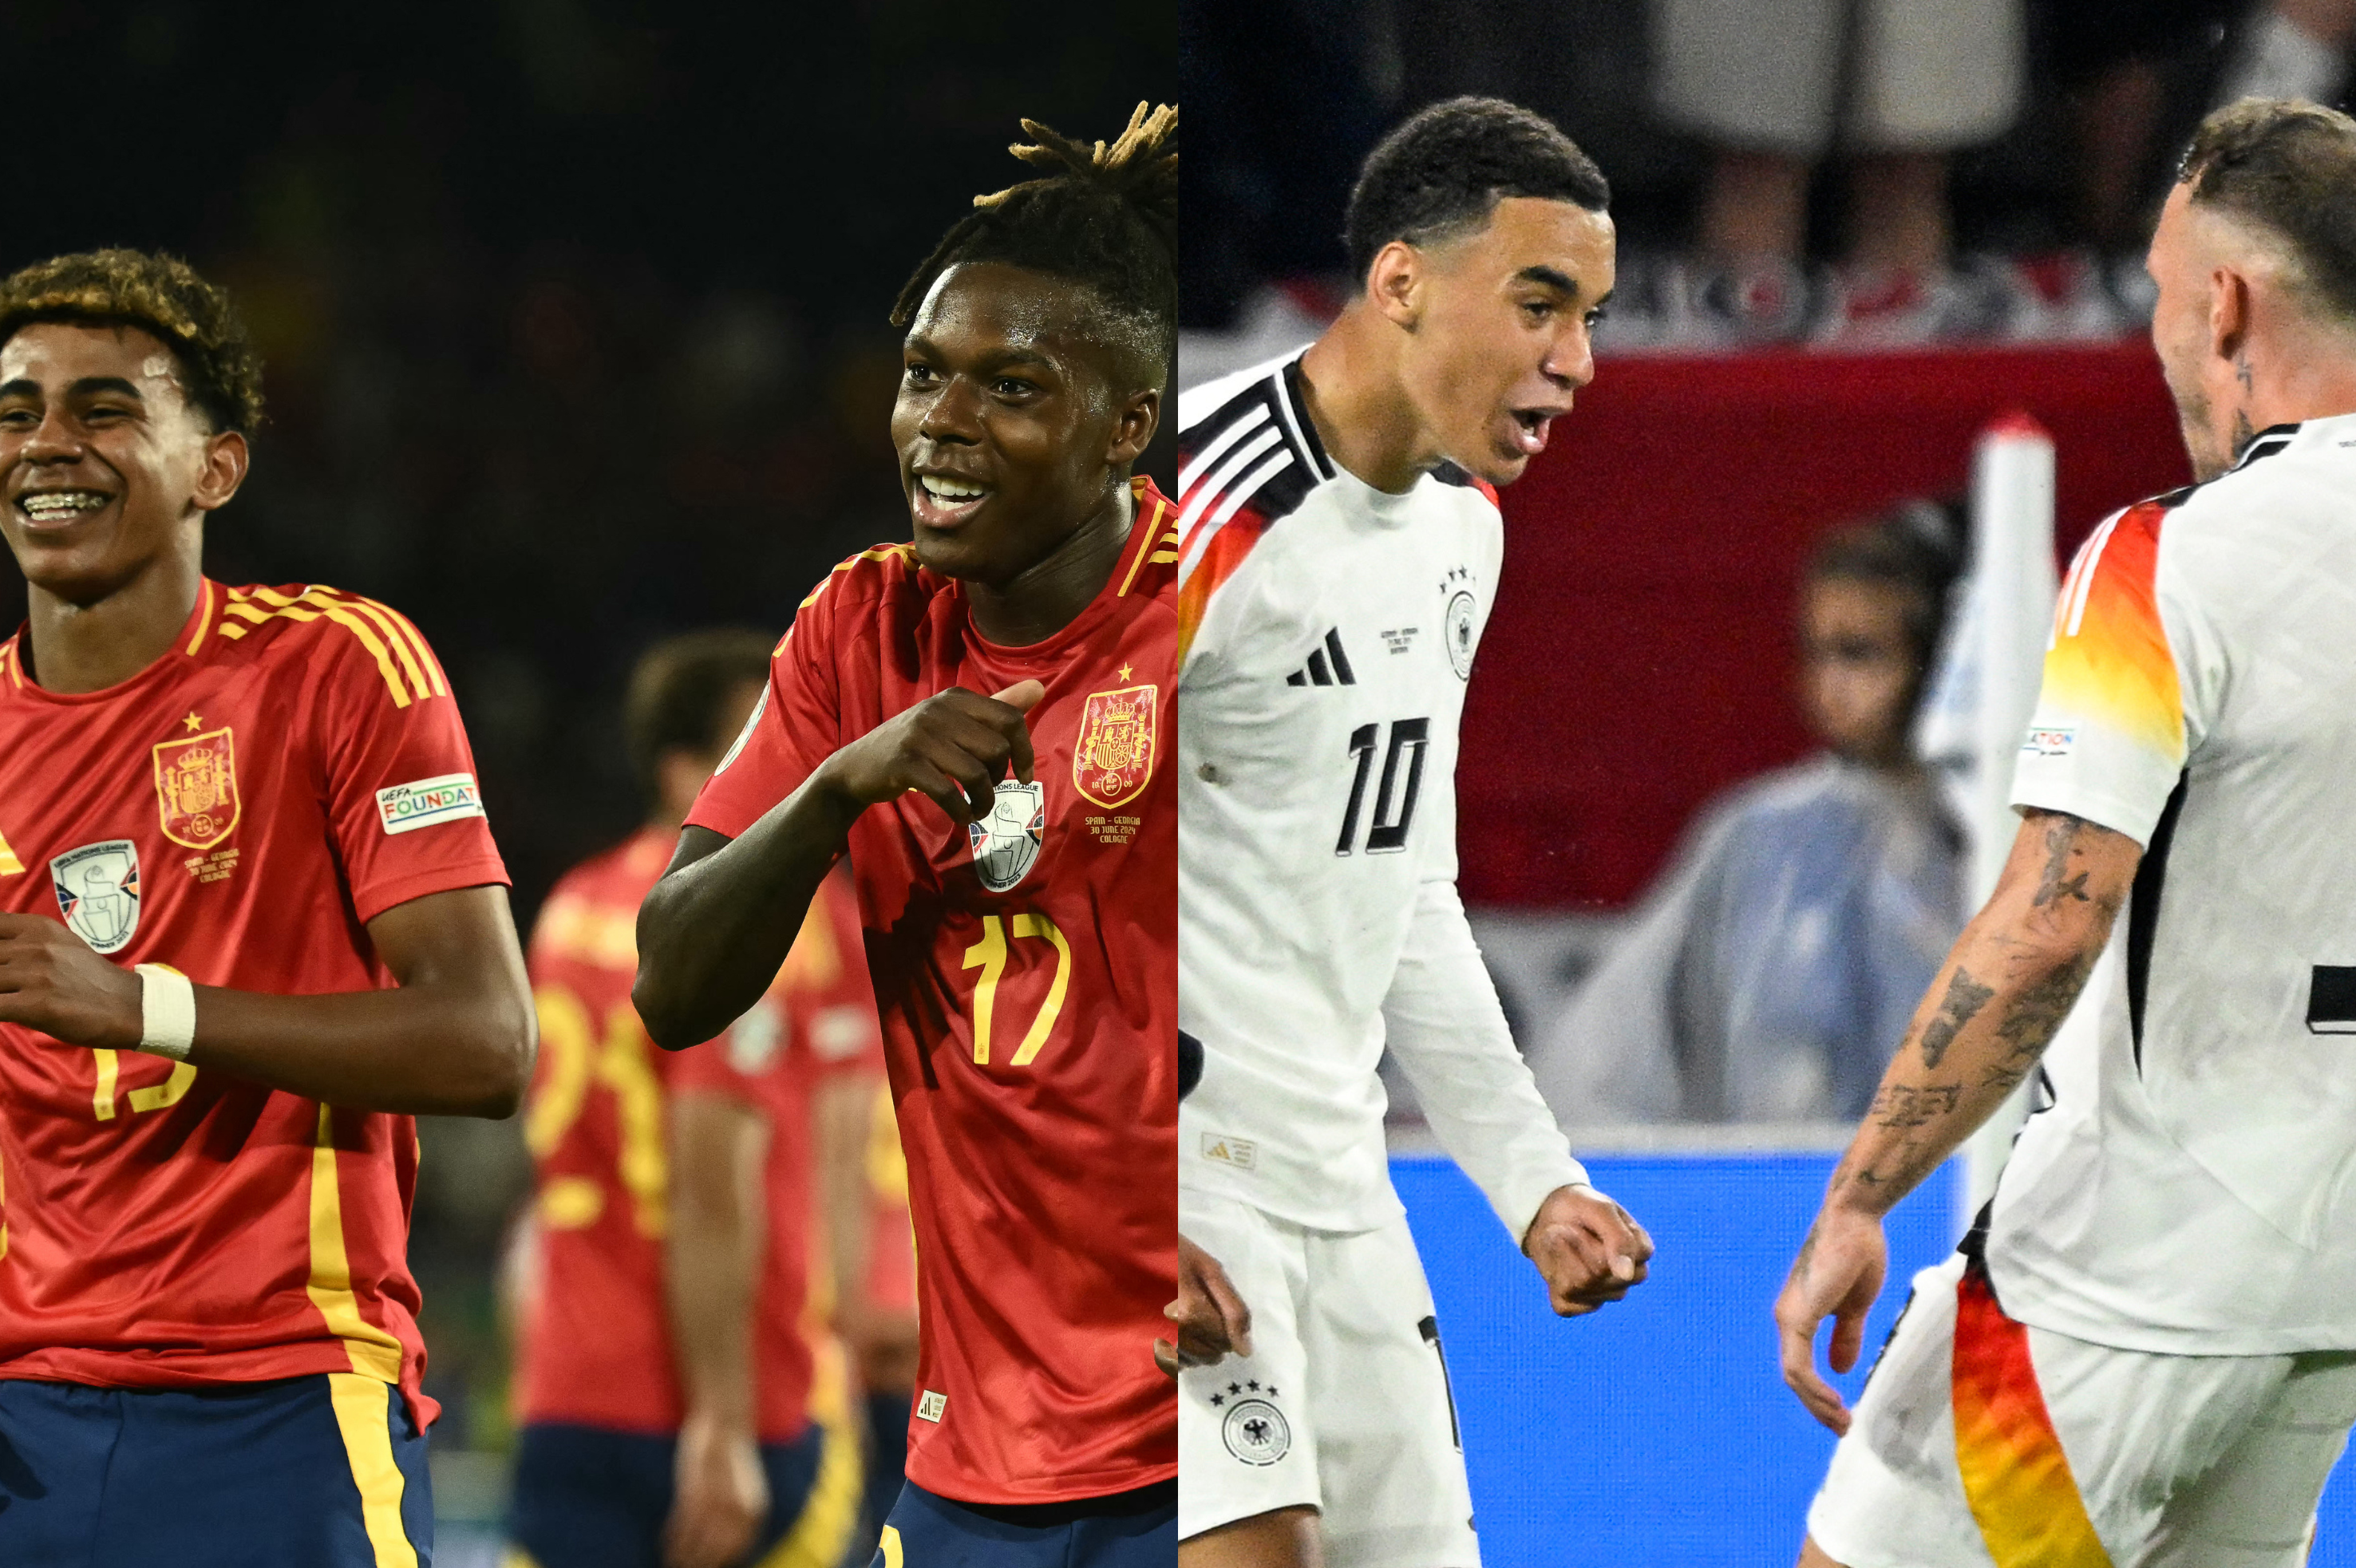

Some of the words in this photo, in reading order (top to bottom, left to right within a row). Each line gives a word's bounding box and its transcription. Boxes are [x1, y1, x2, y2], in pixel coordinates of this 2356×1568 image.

[1014, 783, 1039, 792] LEAGUE
[1335, 717, 1431, 857] 10
[381, 788, 411, 802] UEFA
[383, 788, 475, 819] FOUNDAT
[1085, 816, 1106, 825] SPAIN
[1113, 816, 1140, 826] GEORGIA
[1090, 826, 1100, 835] 30
[1101, 825, 1119, 834] JUNE
[1120, 825, 1136, 835] 2024
[1100, 835, 1129, 844] COLOGNE
[1006, 873, 1022, 886] 2023
[962, 914, 1071, 1065] 17
